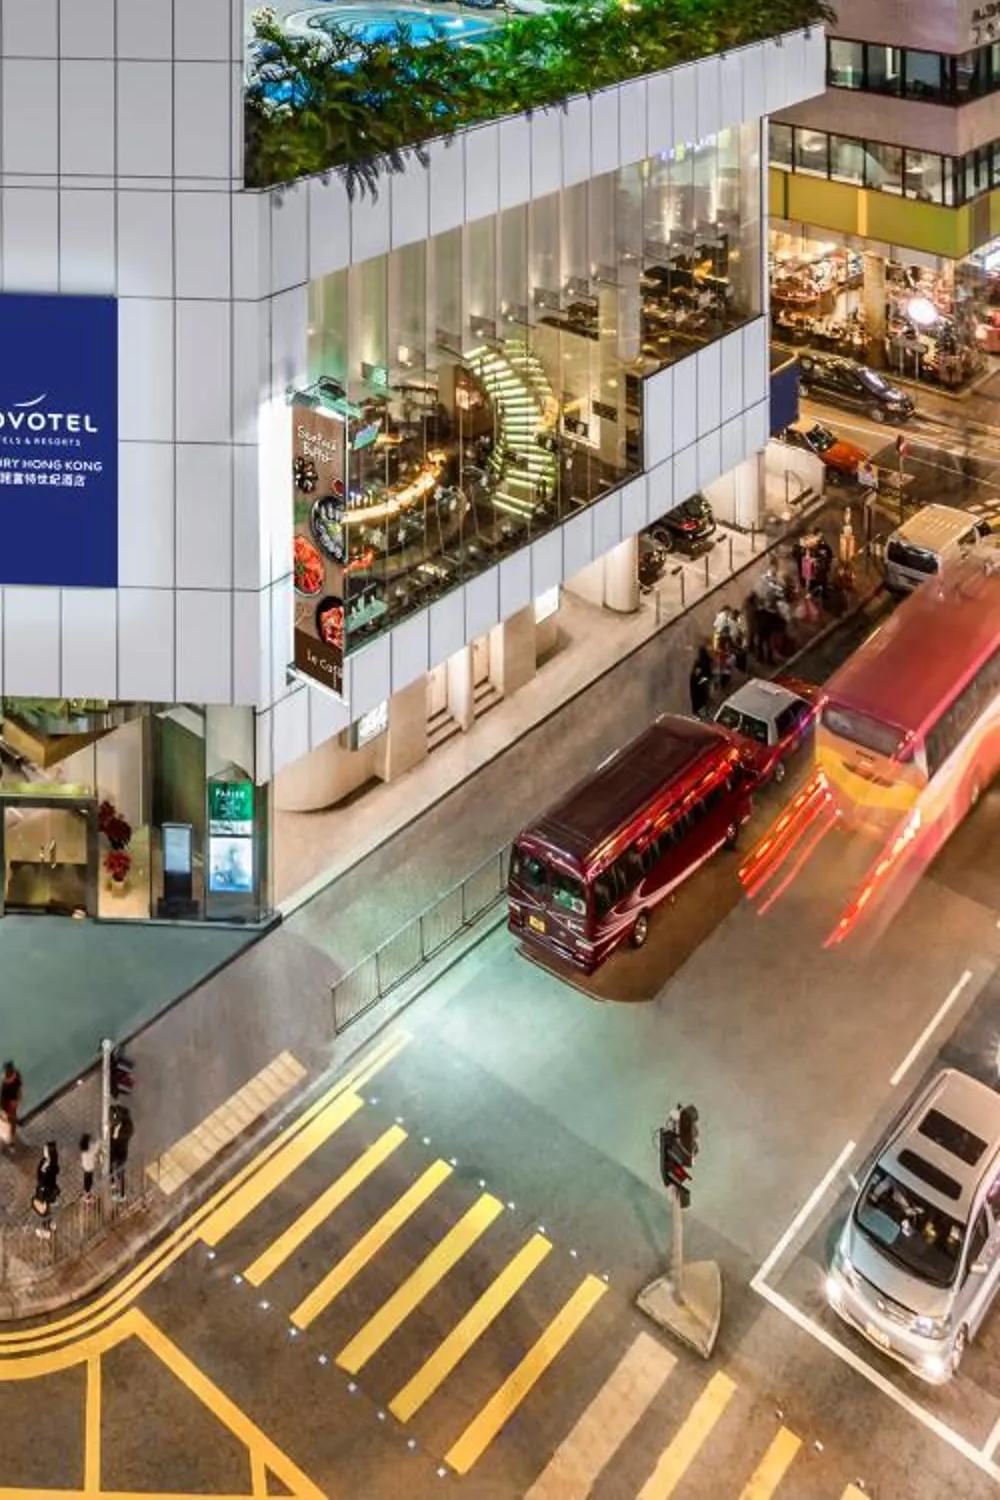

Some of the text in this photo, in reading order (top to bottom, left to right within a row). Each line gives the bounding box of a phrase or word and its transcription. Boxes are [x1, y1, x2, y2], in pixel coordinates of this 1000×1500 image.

[24, 437, 31, 445] &
[33, 437, 81, 447] RESORTS
[22, 458, 63, 471] HONG
[65, 460, 103, 472] KONG
